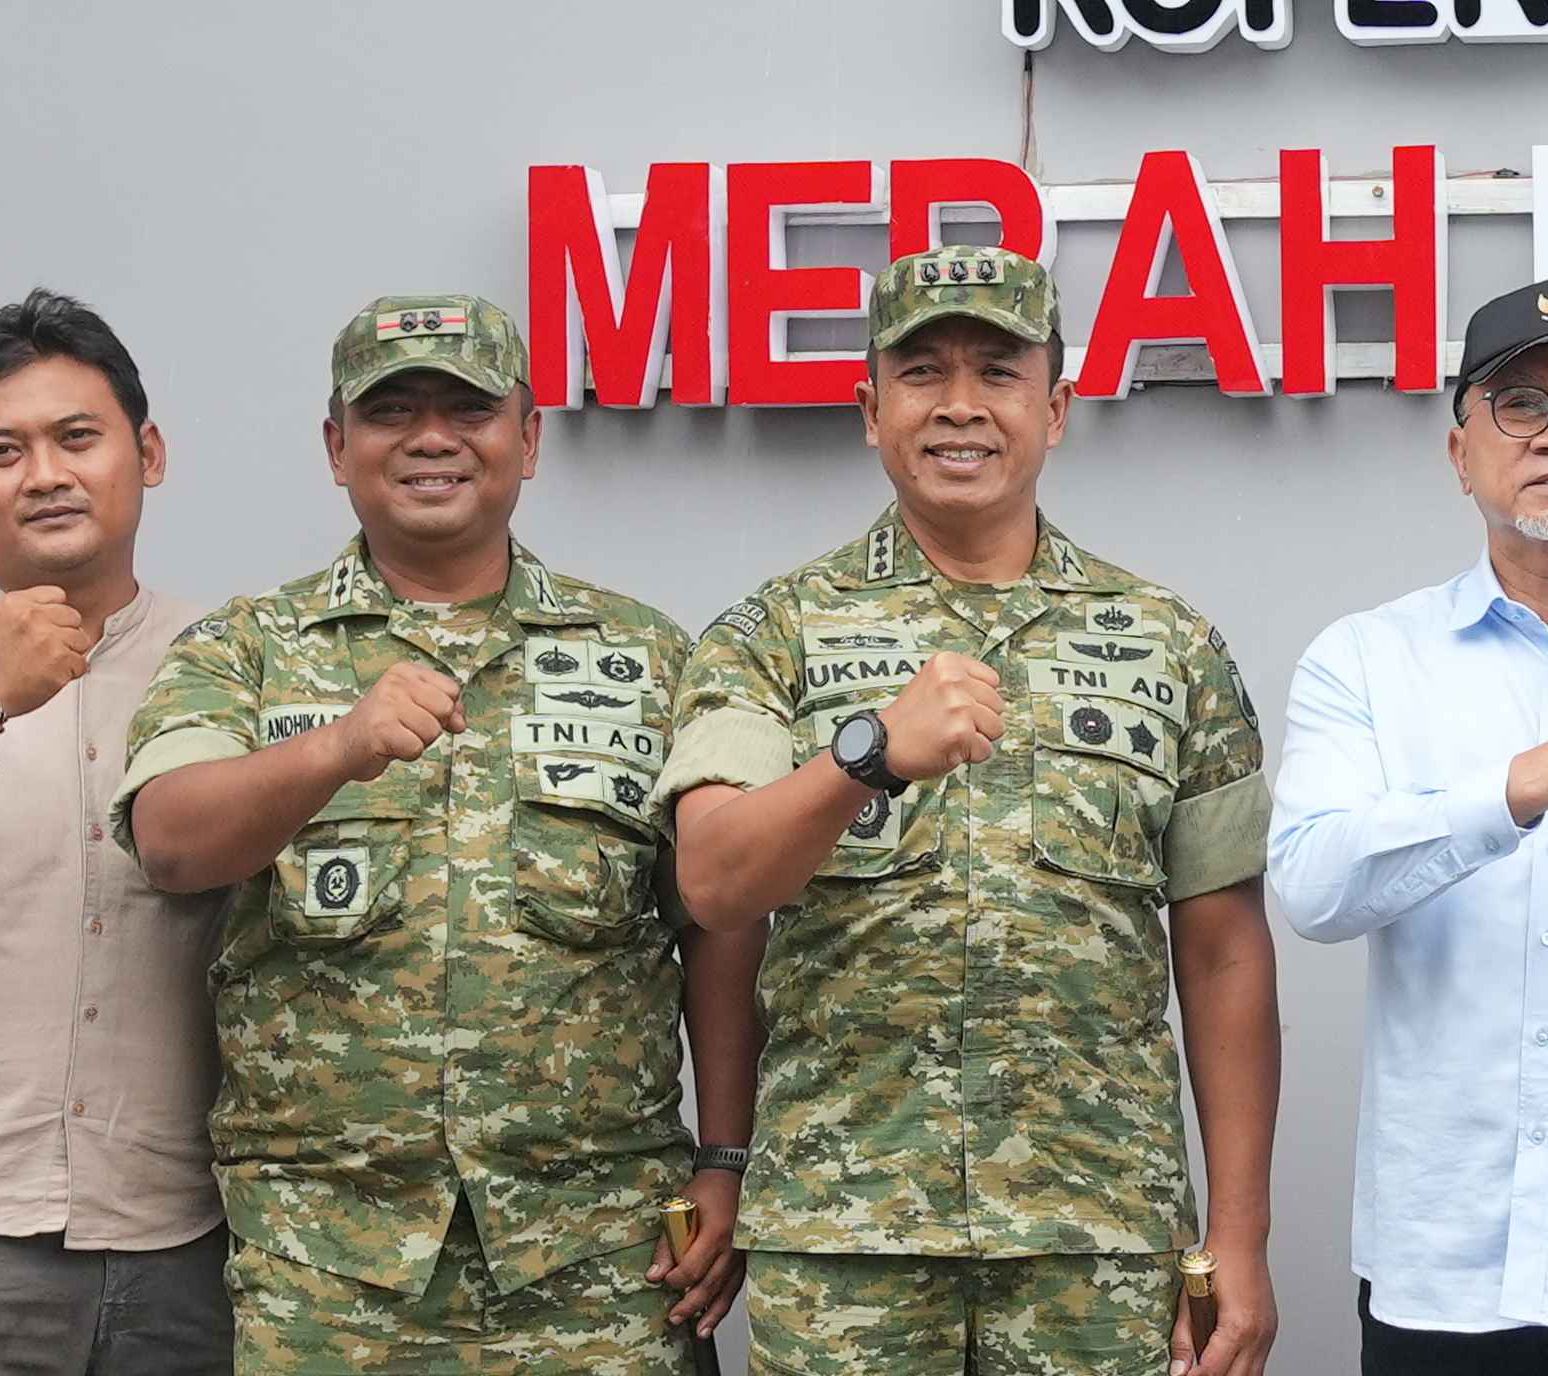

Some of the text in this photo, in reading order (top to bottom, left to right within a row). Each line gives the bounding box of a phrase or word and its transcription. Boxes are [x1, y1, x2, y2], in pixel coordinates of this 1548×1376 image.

[804, 656, 927, 691] UKMA
[1049, 666, 1175, 706] TNI AD
[266, 713, 327, 743] ANDHIKA
[525, 722, 654, 757] TNI AD
